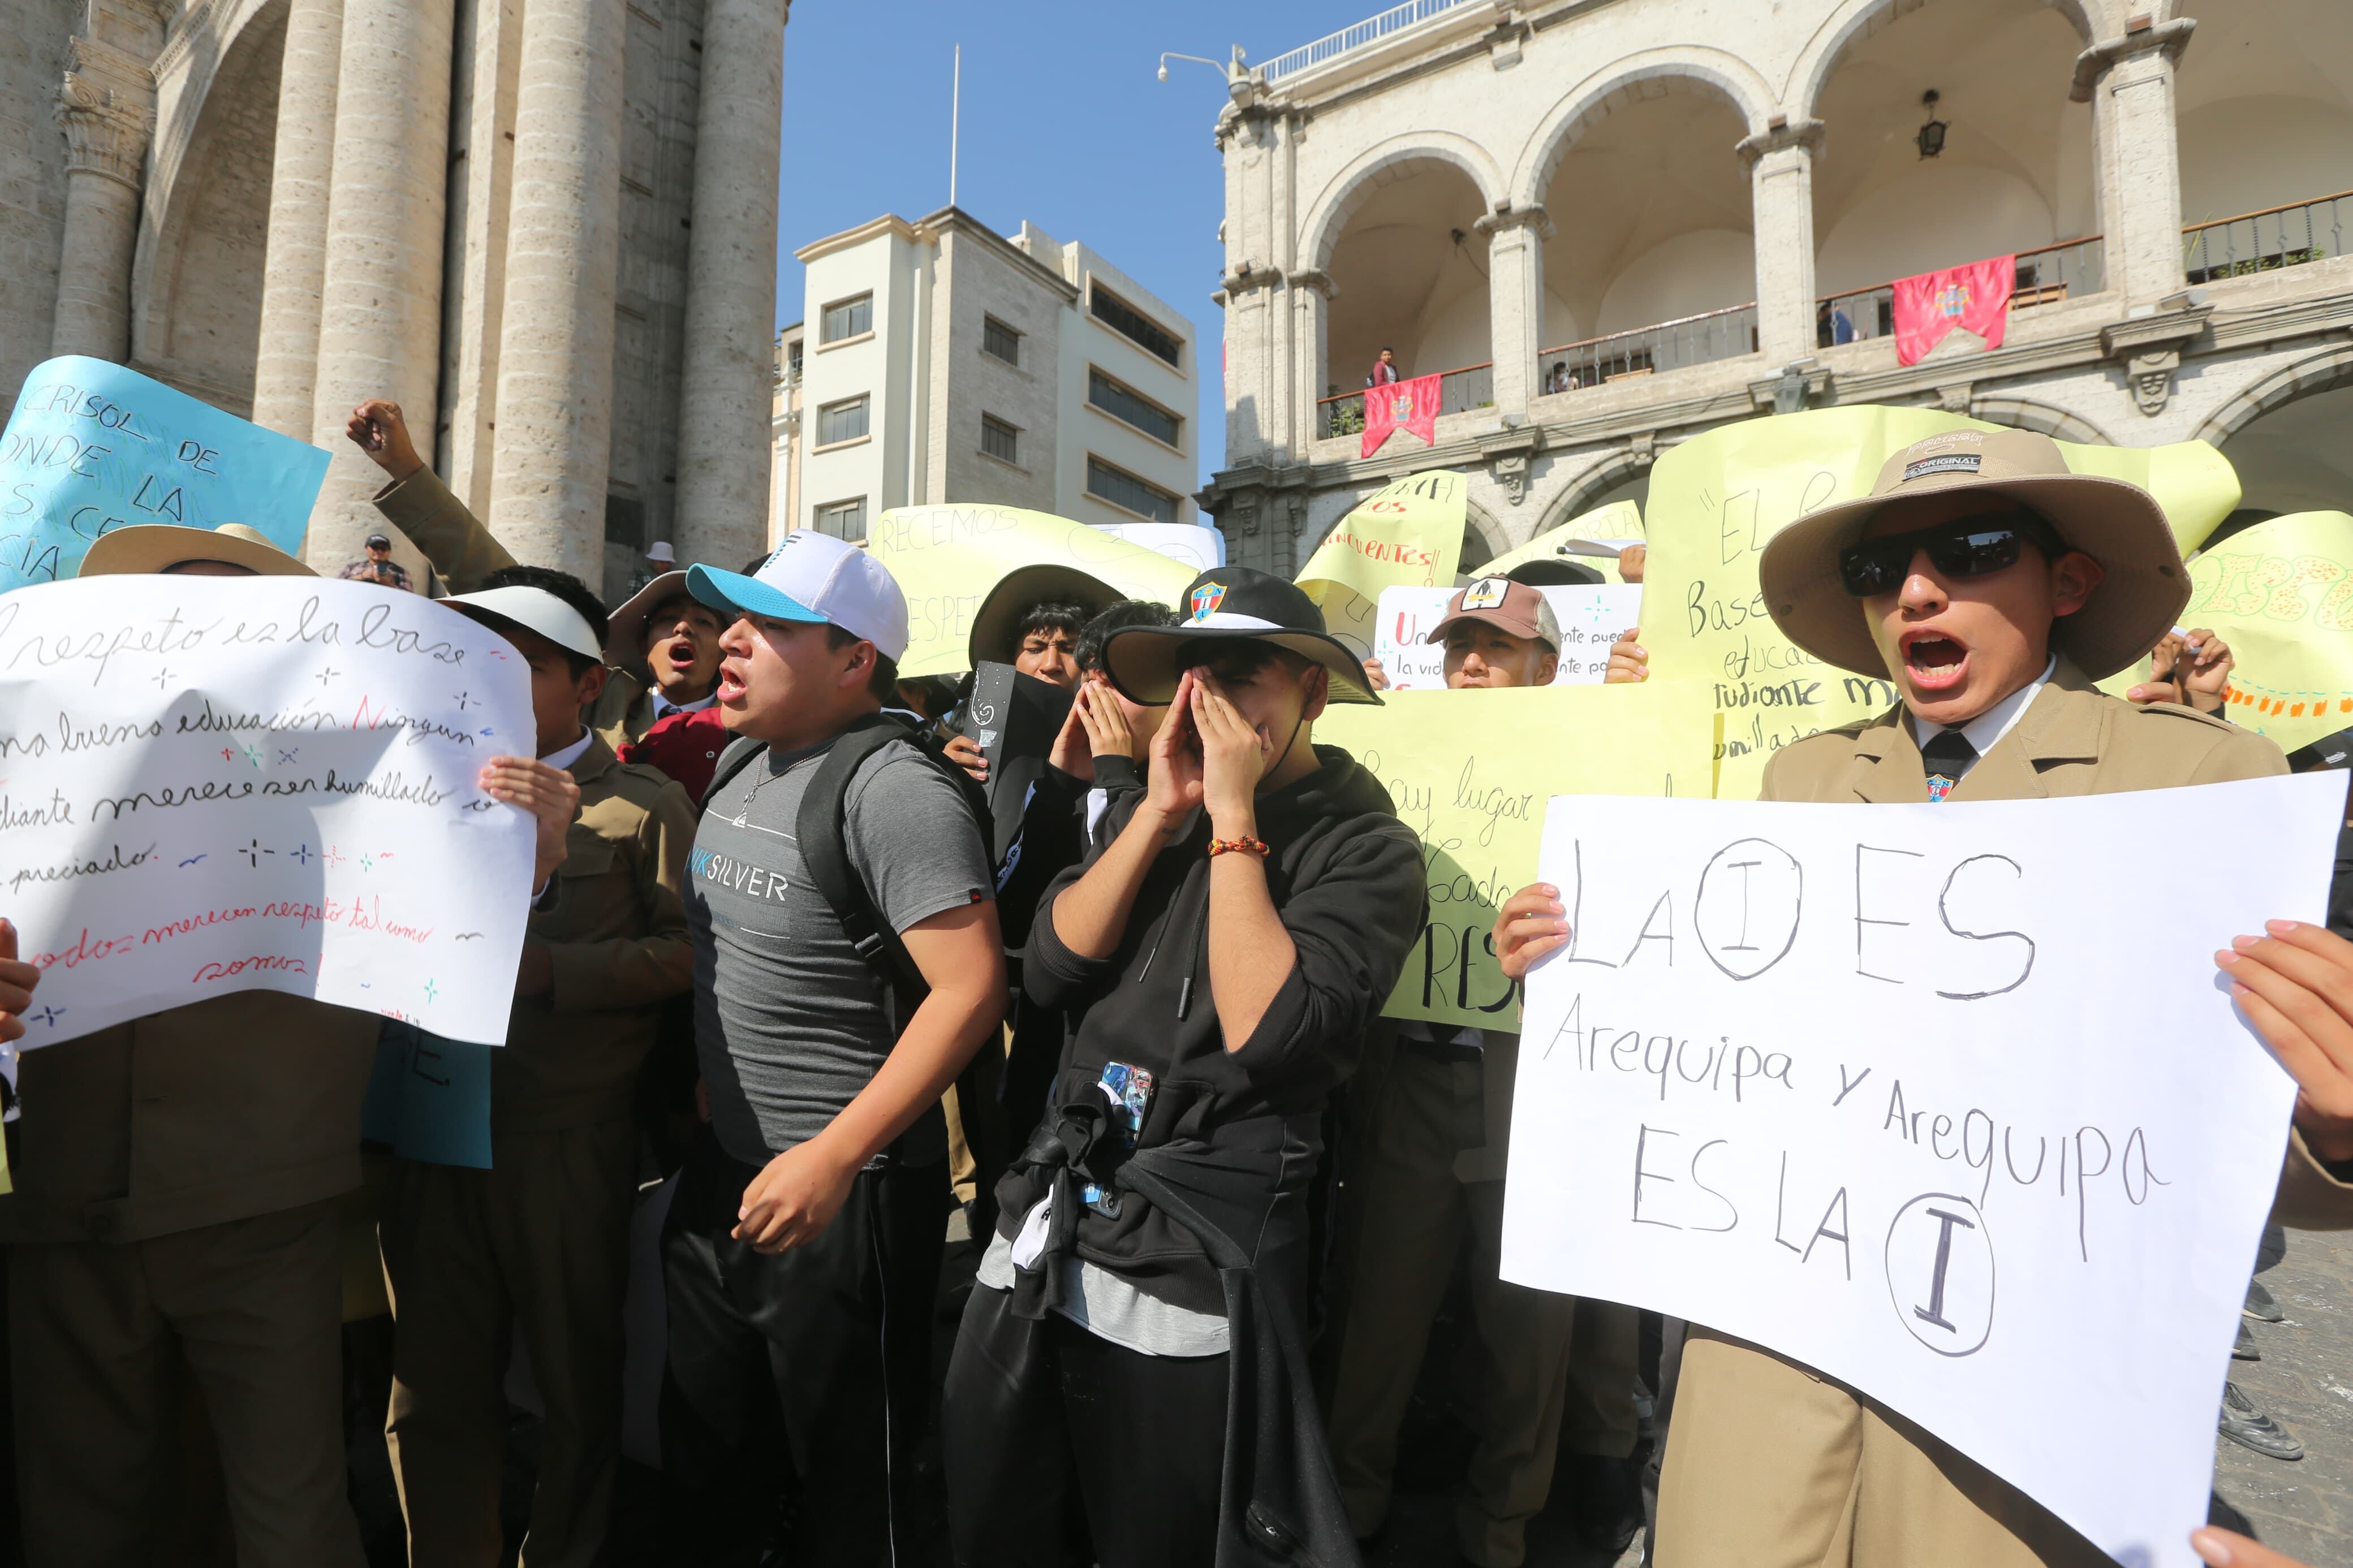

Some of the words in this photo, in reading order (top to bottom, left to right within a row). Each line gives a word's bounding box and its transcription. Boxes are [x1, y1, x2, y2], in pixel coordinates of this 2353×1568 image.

[23, 385, 149, 441] CRISOL
[178, 440, 219, 476] DE
[1919, 456, 1981, 469] ORIGINAL
[132, 473, 183, 522] LA
[287, 595, 341, 646] la
[1397, 654, 1412, 675] la
[1420, 660, 1444, 676] vid
[1453, 755, 1533, 847] lugar
[1567, 837, 1675, 969] LA
[1854, 843, 2036, 1001] ES
[1631, 1122, 1739, 1233] ES
[1774, 1150, 1852, 1282] LA
